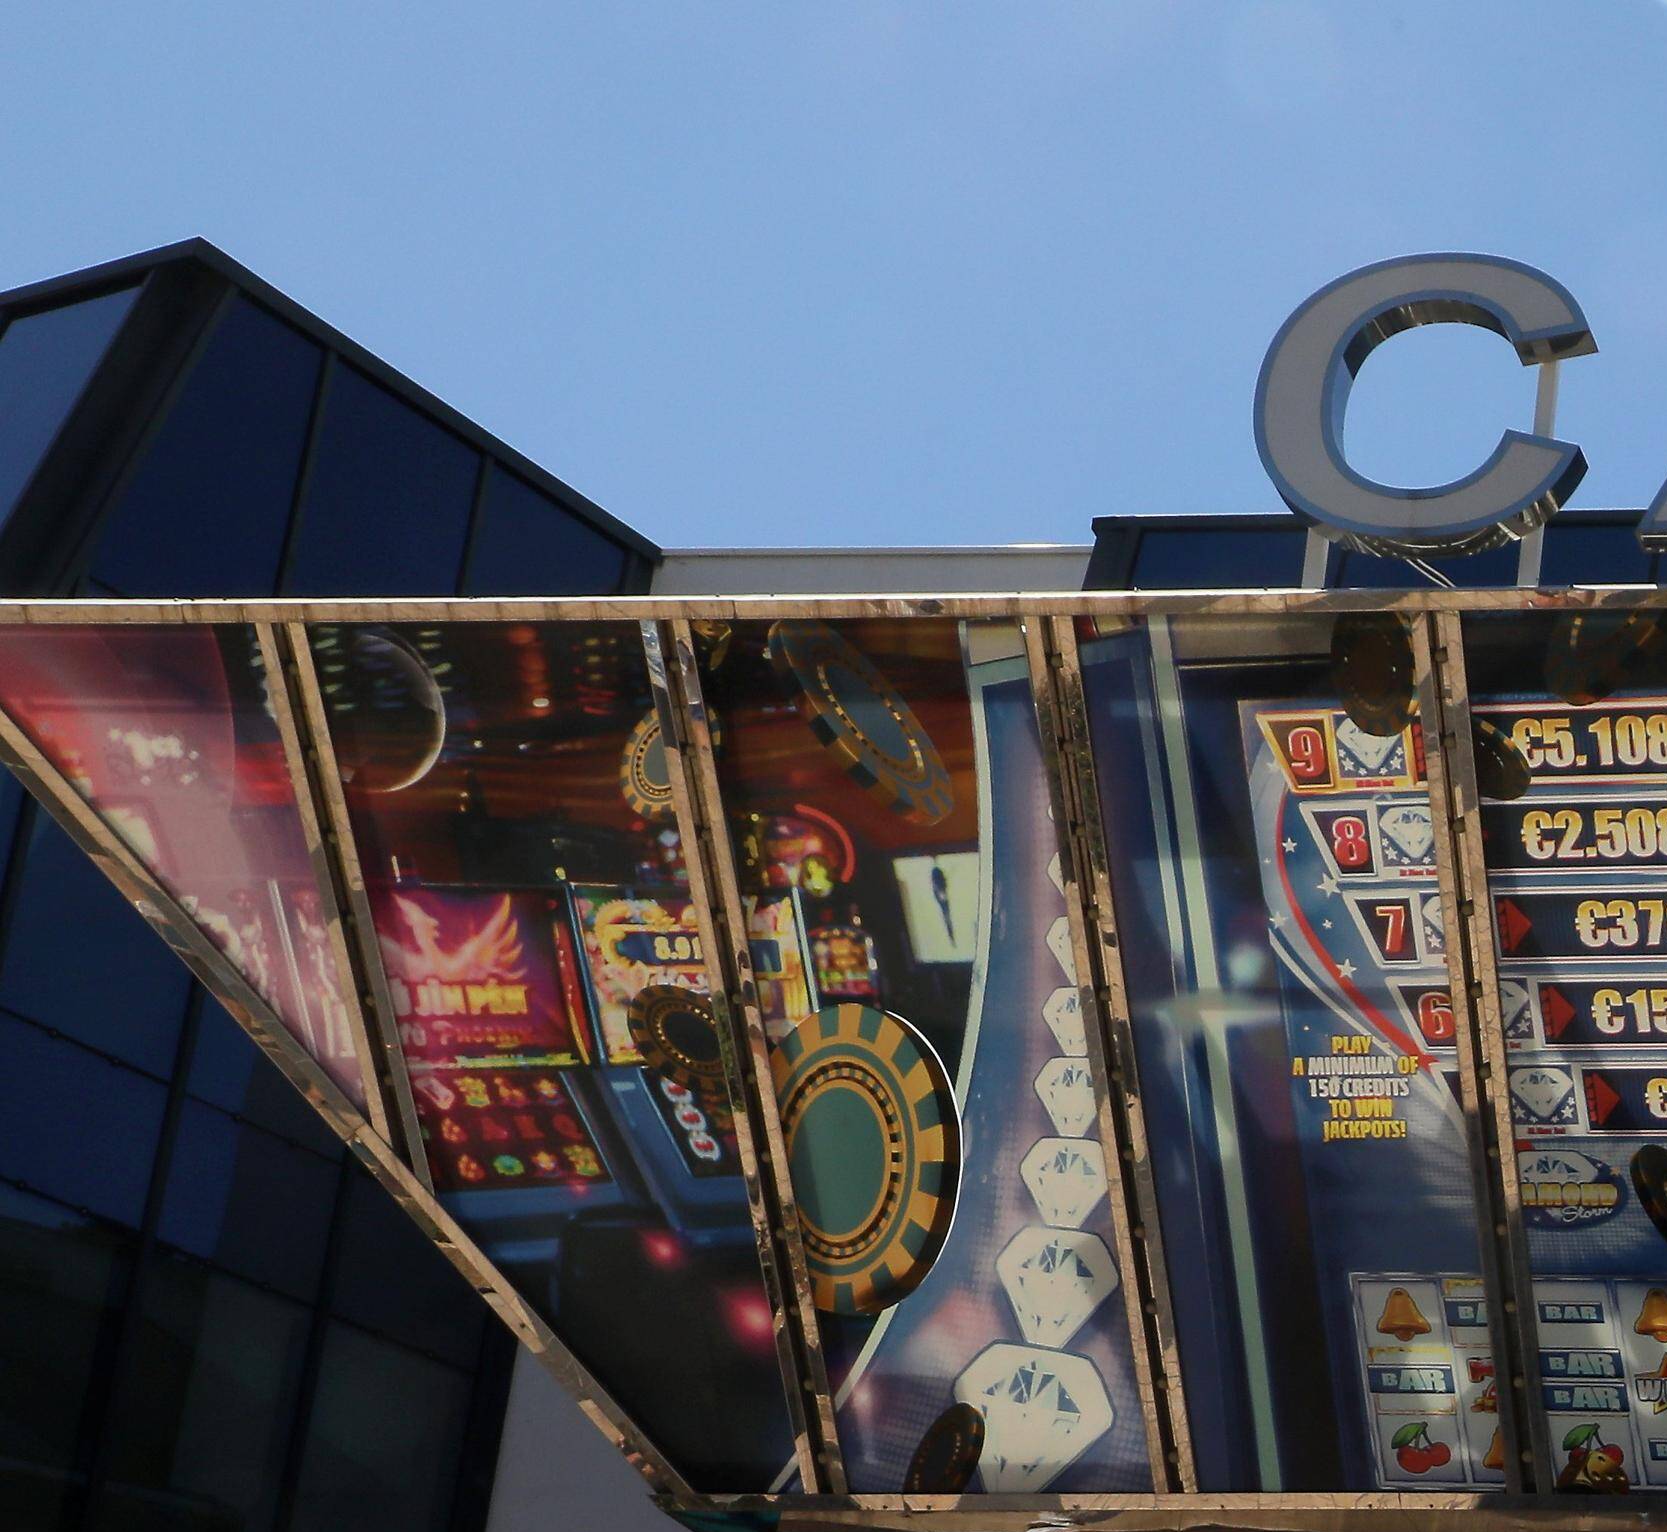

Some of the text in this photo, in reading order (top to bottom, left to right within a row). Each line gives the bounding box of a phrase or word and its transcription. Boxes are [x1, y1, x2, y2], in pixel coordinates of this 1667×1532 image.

[1288, 725, 1326, 778] 9
[1331, 815, 1373, 867] 8
[1375, 905, 1406, 954] 7
[1417, 992, 1452, 1040] 6
[1331, 1036, 1374, 1055] PLAY
[1291, 1054, 1420, 1076] A MINIMUM OF
[1309, 1078, 1410, 1098] 150 CREDITS
[1329, 1098, 1393, 1119] TO WIN
[1322, 1120, 1407, 1142] JACKPOTS!
[1560, 1204, 1614, 1223] Storm
[1544, 1304, 1597, 1322] BAR
[1548, 1351, 1619, 1378] BAR
[1382, 1369, 1448, 1394] BAR
[1553, 1386, 1624, 1412] BAR
